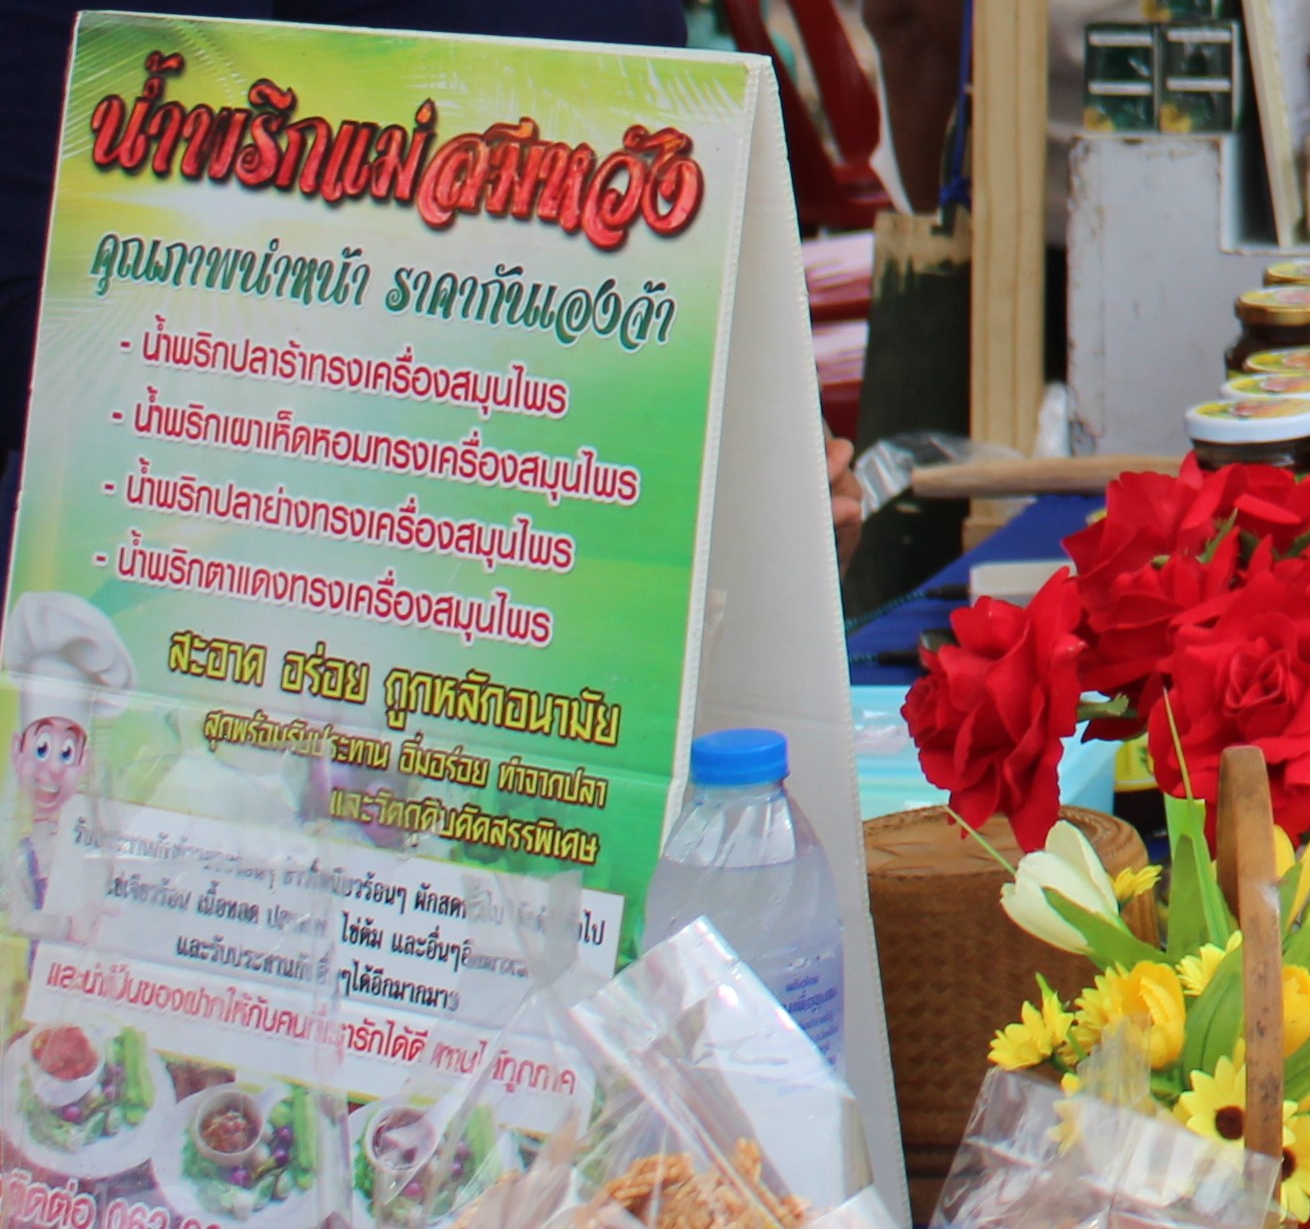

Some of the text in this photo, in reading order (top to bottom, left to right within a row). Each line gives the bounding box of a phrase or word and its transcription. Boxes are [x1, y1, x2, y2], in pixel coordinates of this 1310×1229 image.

[90, 233, 371, 306] คุณภาพนำหน้า
[142, 316, 568, 417] น้ำพริกปลาร้าทรงเครื่องสมุนไพร
[134, 387, 639, 503] น้ำพริกเผาเห็ดหอมทรงเครื่องสมุนไพร
[126, 458, 573, 569] น้ำพริกปลาย่างทรงเครื่องสมุนไพร
[118, 531, 552, 644] น้ำพริกตาแดงทรงเครื่องสมุนไพร
[169, 631, 621, 745] สะอาด อร่อย ถูกหลักอนามัย
[399, 731, 490, 788] อิ่มอร่อย
[498, 755, 608, 808] ทำจากปลา
